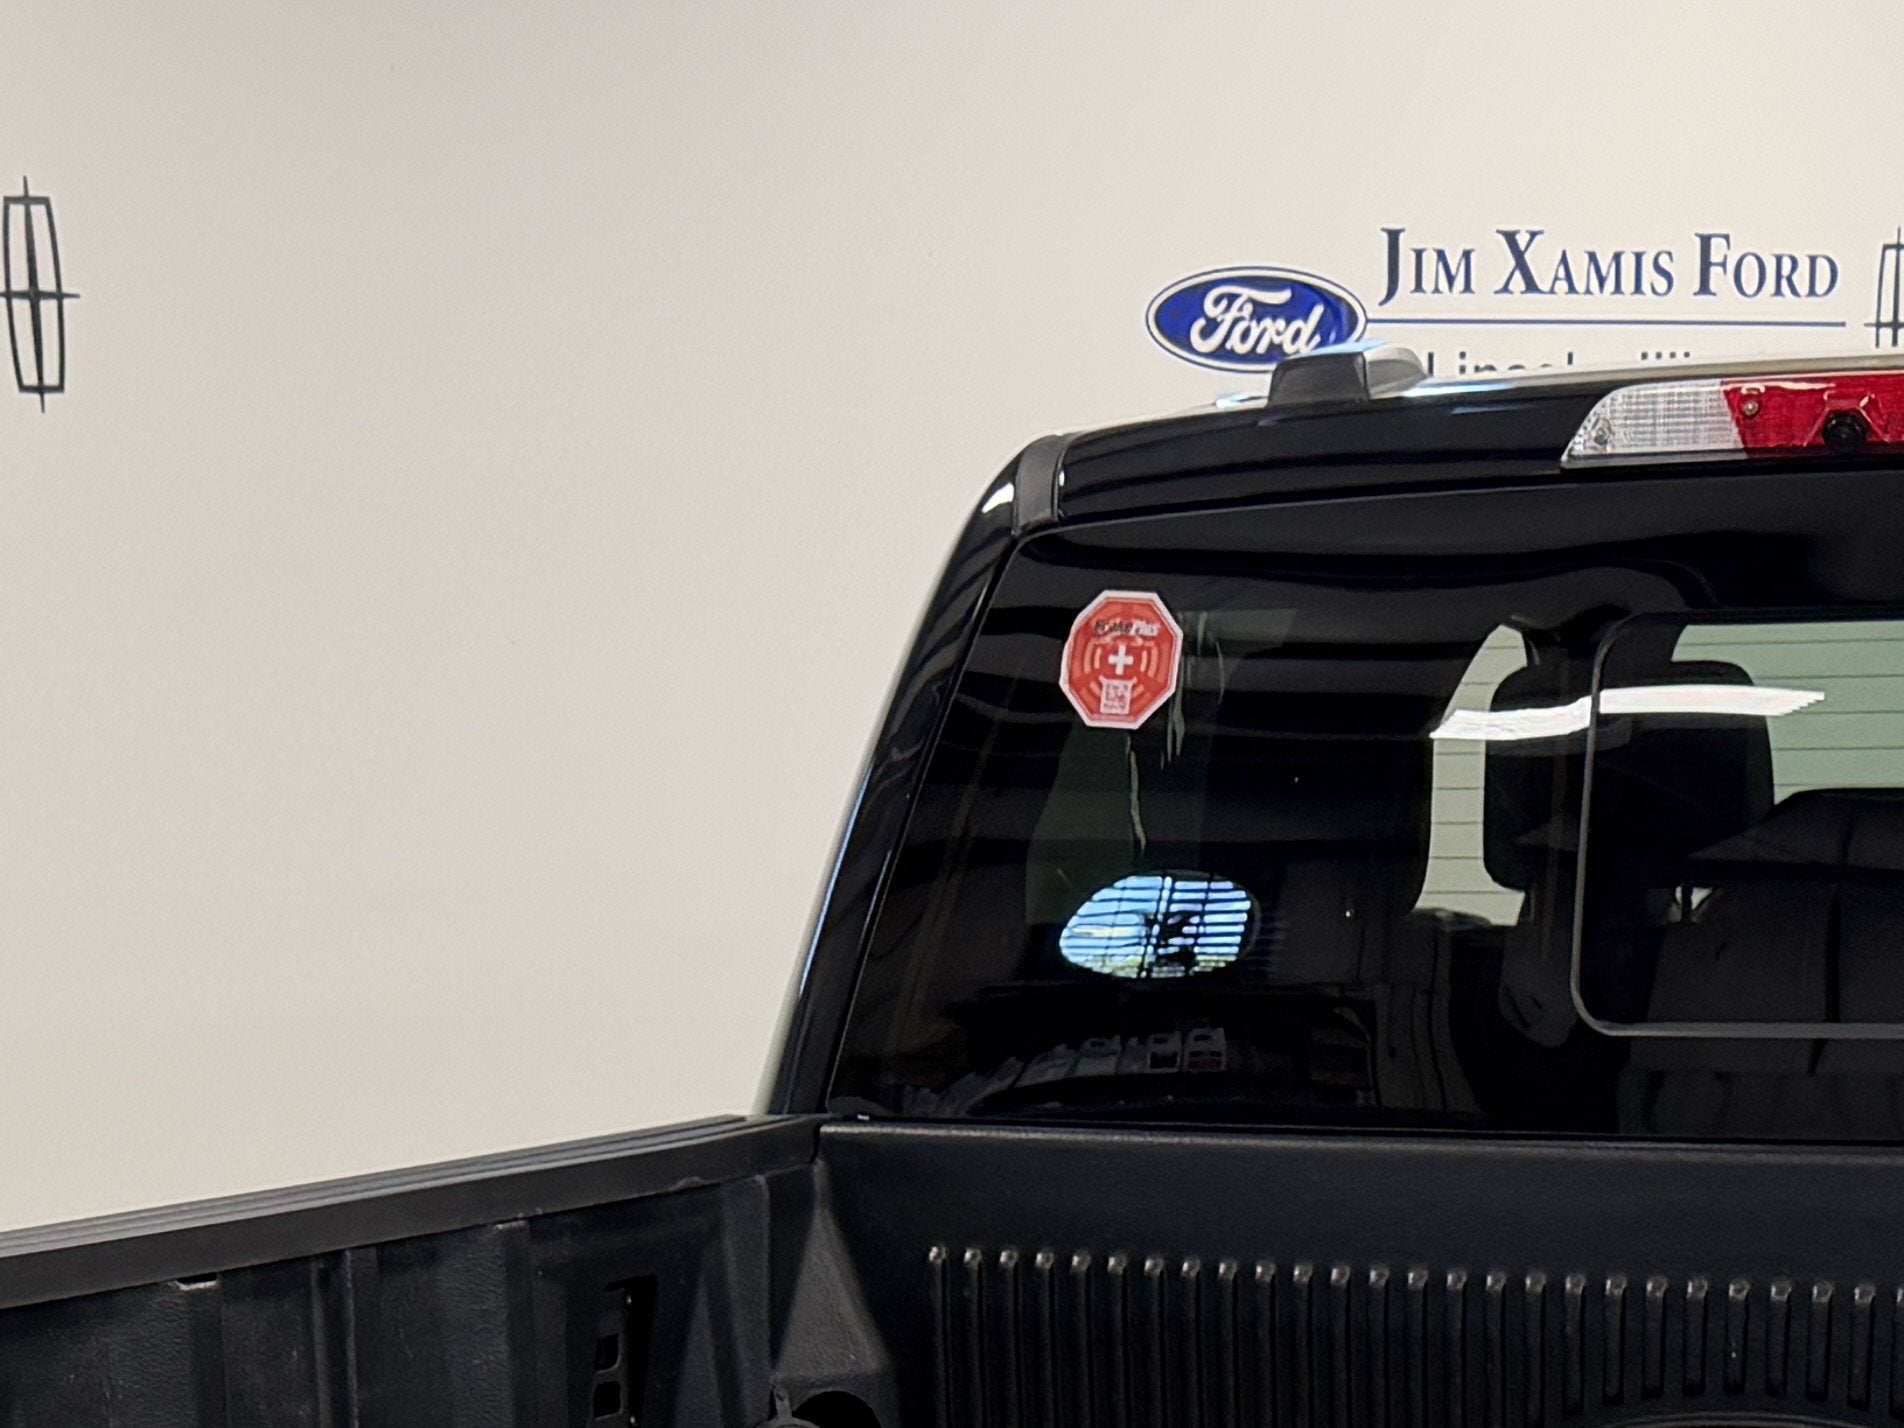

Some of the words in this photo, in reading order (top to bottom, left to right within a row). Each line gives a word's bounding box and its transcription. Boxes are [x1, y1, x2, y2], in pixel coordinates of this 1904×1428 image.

[1378, 227, 1475, 307] JIM
[1493, 229, 1674, 298] XAMIS
[1693, 232, 1839, 299] FORD
[1189, 284, 1325, 355] Ford
